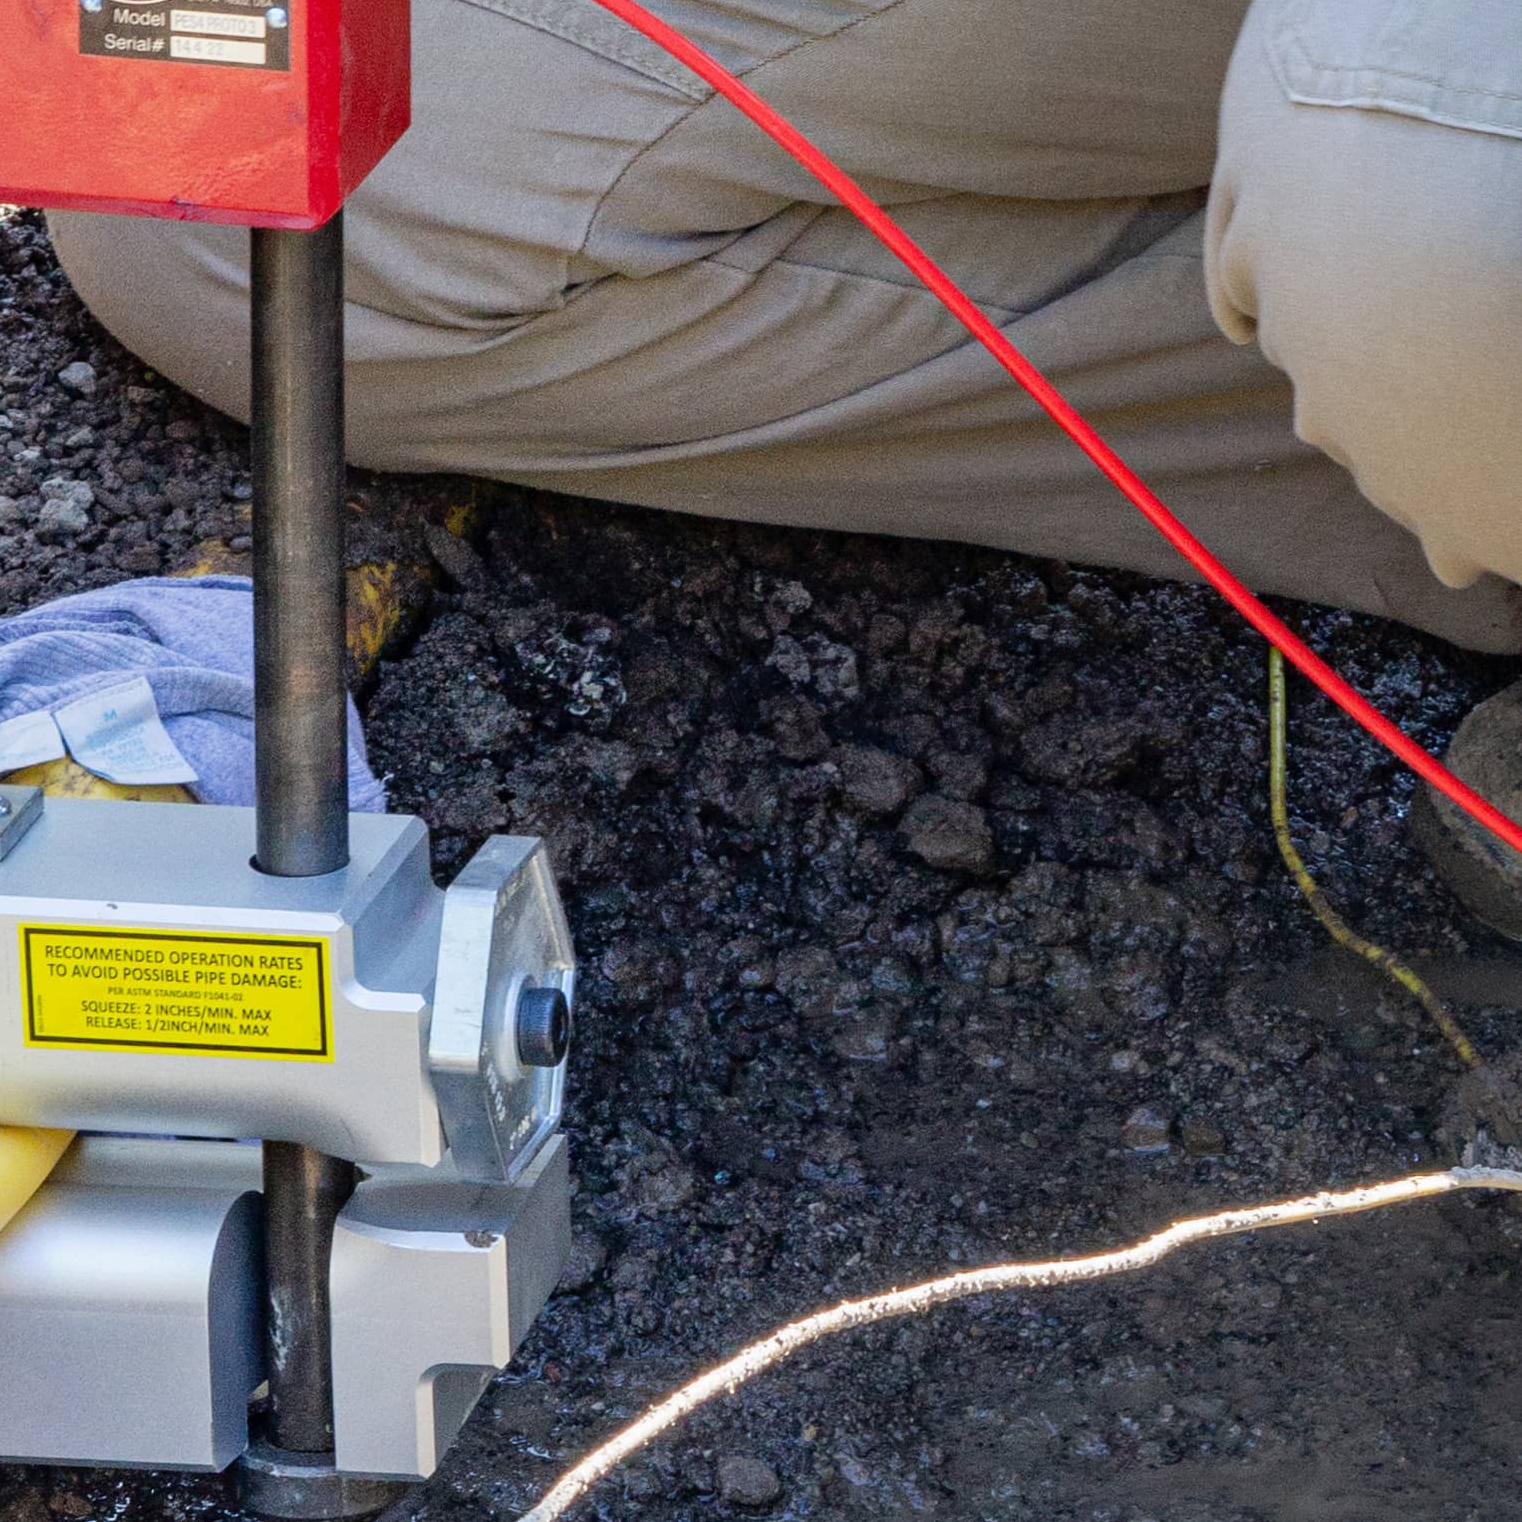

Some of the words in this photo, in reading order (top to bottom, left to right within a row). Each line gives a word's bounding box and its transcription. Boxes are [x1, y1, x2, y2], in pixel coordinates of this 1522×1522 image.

[113, 8, 165, 26] Model
[104, 34, 165, 52] Serial#
[45, 945, 164, 964] RECOMMENDED
[169, 951, 254, 968] OPERATION
[259, 956, 303, 970] RATES
[47, 963, 67, 977] TO
[71, 965, 118, 979] AVOID
[123, 967, 190, 983] POSSIBLE
[195, 971, 226, 985] PIPE
[231, 973, 302, 989] DAMAGE:
[108, 987, 124, 996] PER
[126, 988, 151, 997] ASTM
[154, 989, 201, 999] STANDARD
[81, 1000, 141, 1015] SQUEEZE:
[145, 1004, 151, 1015] 2
[156, 1004, 238, 1020] INCHES/MIN.
[242, 1009, 272, 1021] MAX
[86, 1016, 142, 1030] RELEASE:
[239, 1024, 269, 1036] MAX
